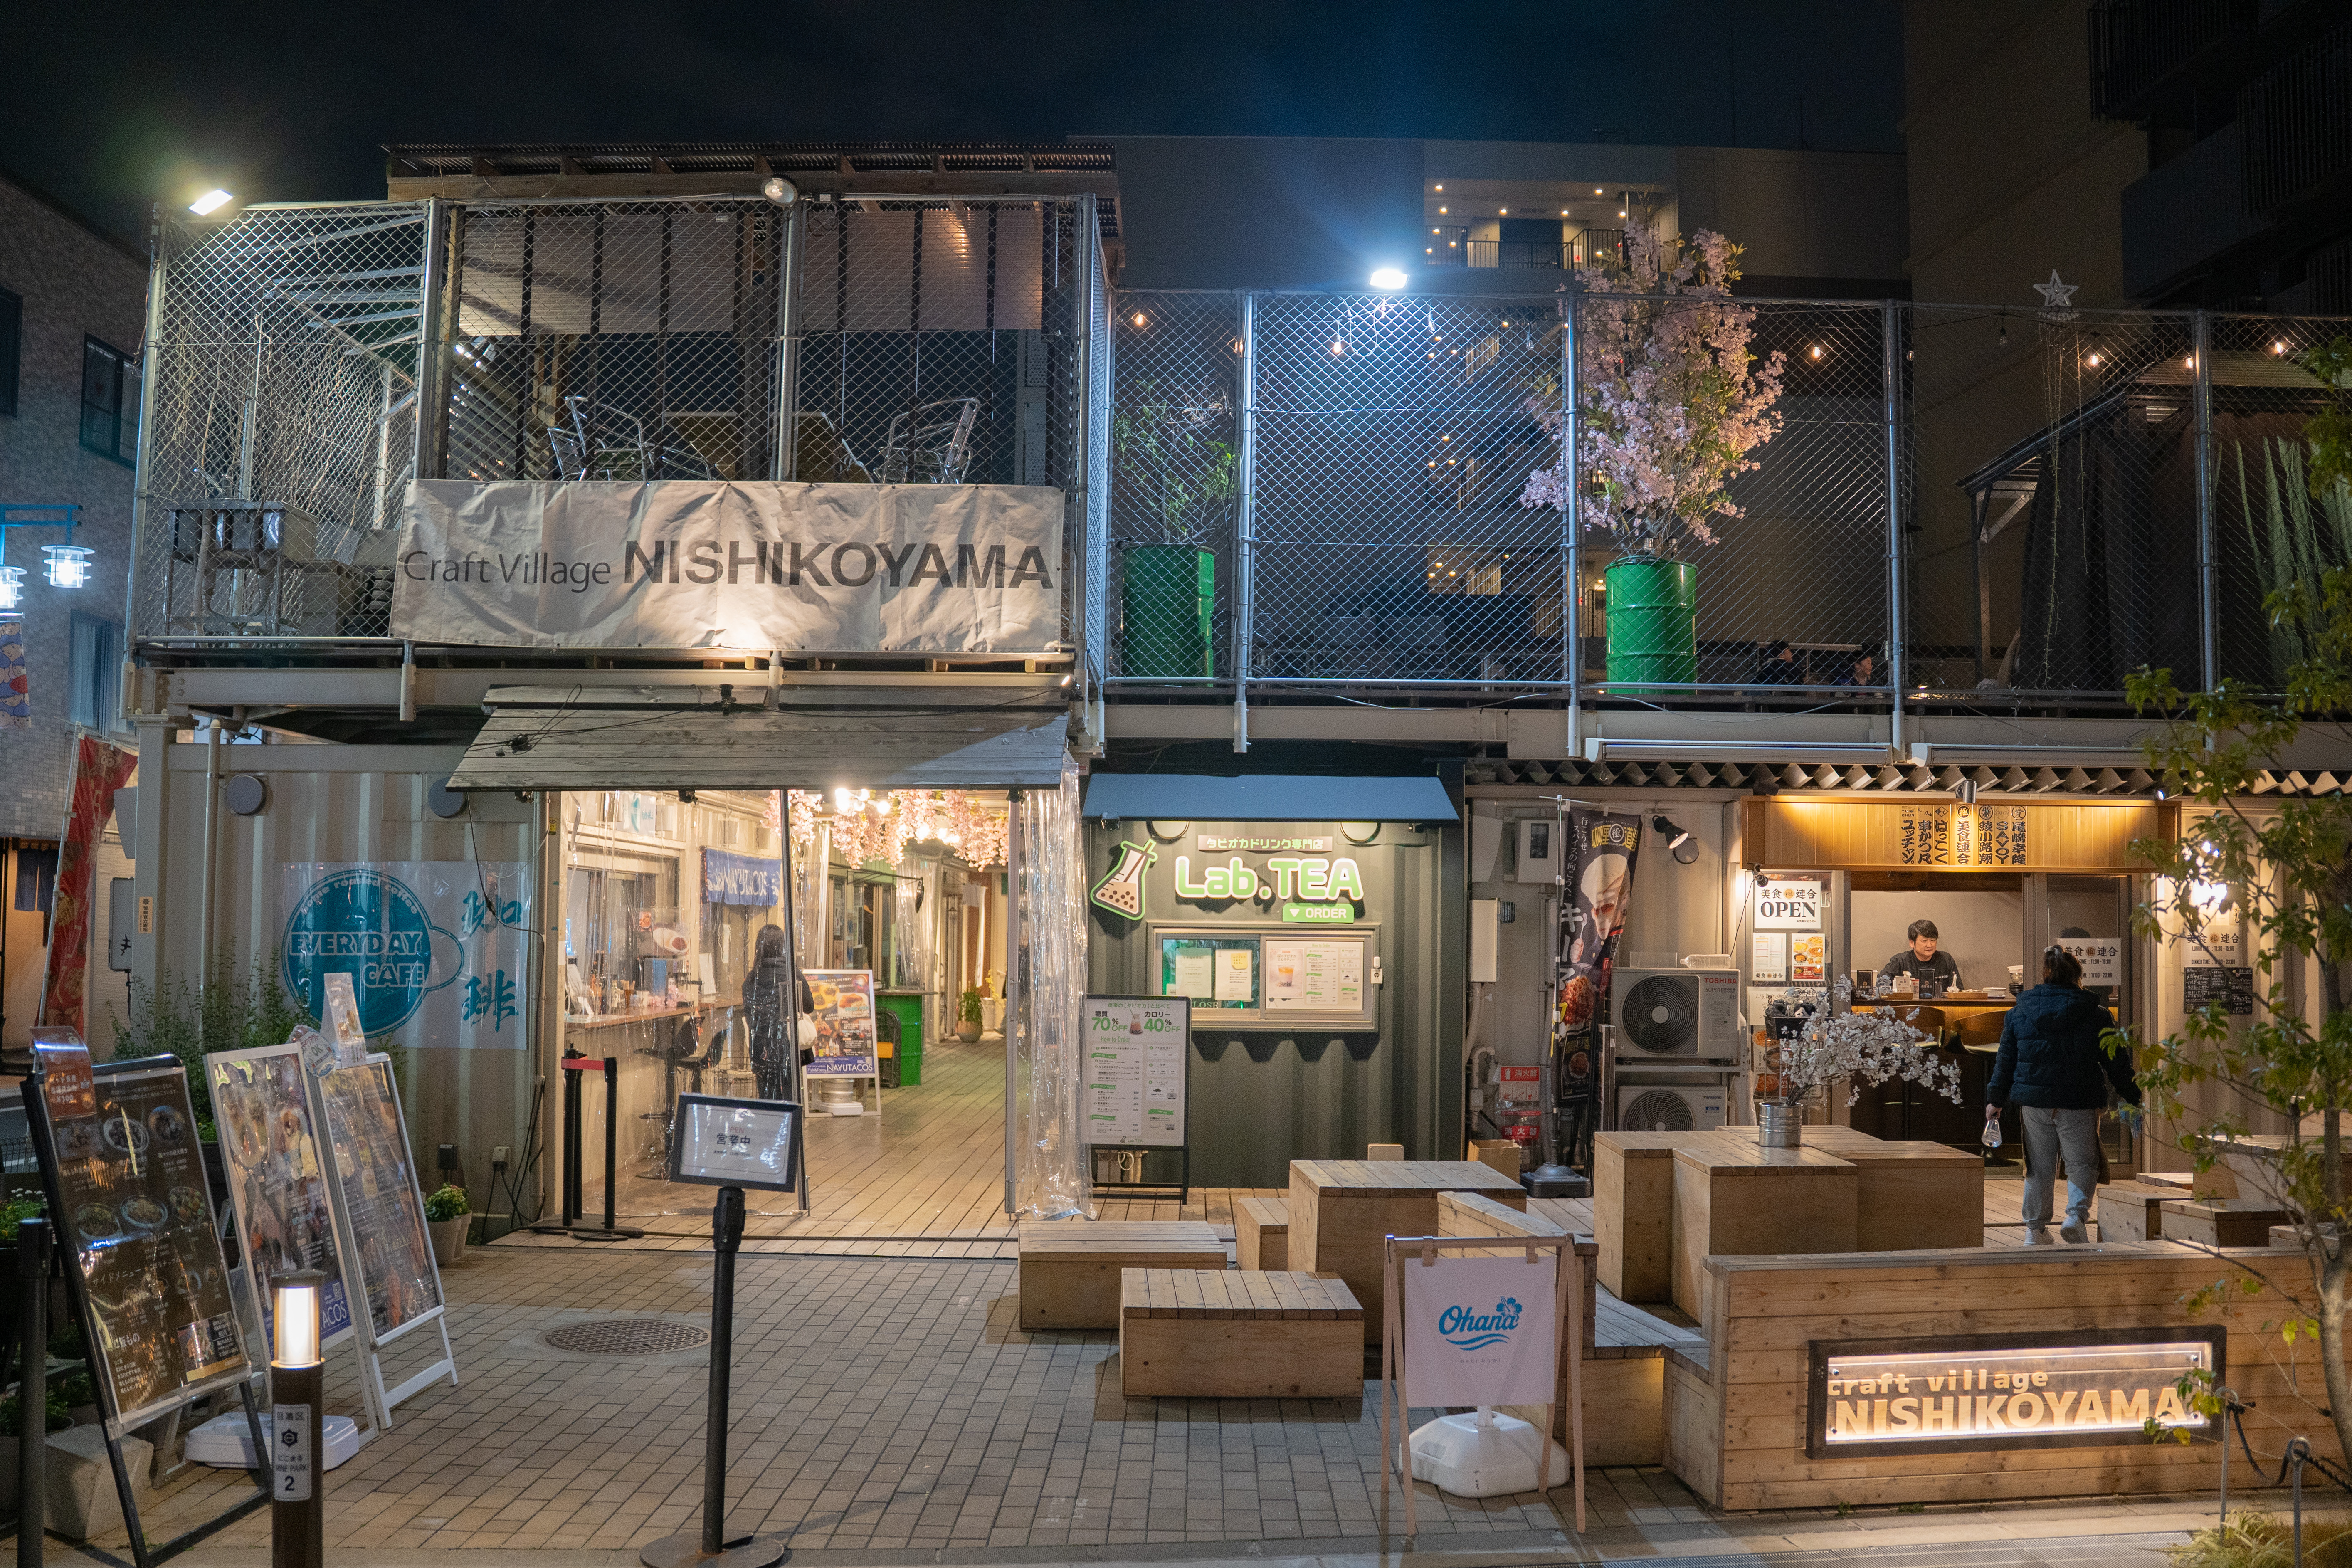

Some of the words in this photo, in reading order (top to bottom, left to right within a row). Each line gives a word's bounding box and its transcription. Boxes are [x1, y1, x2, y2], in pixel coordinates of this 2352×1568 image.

[402, 550, 493, 584] Craft
[499, 551, 611, 593] Village
[624, 539, 1054, 590] NISHIKOYAMA
[1207, 838, 1324, 849] タピオカドリンク専門店
[1935, 820, 1949, 864] はっこく
[1956, 820, 1971, 864] 美食連合
[1978, 820, 1993, 865] 綾小路翔
[1995, 820, 2009, 864] SAVOY
[1563, 825, 1580, 897] スパイスの向こうへ。
[1175, 855, 1364, 901] Lab.TEA
[301, 886, 330, 914] home
[334, 877, 379, 889] roasted
[385, 883, 418, 914] coffee
[1305, 908, 1347, 919] ORDER
[1760, 901, 1816, 917] OPEN
[290, 931, 423, 956] EVERYDAY
[364, 963, 425, 988] CAFE
[1091, 1017, 1111, 1031] 70
[1144, 1018, 1164, 1032] 40
[311, 1044, 323, 1056] OK
[827, 1064, 873, 1072] NAYUTACOS
[716, 1133, 750, 1146] 営業中
[1504, 1127, 1537, 1136] 消火器
[91, 1269, 141, 1287] サイドメニュー
[1438, 1305, 1519, 1335] Ohana
[1828, 1373, 1910, 1396] craft
[1927, 1369, 2048, 1394] village
[1835, 1387, 2188, 1436] NISHIKOYAMA
[284, 1476, 294, 1491] 2
